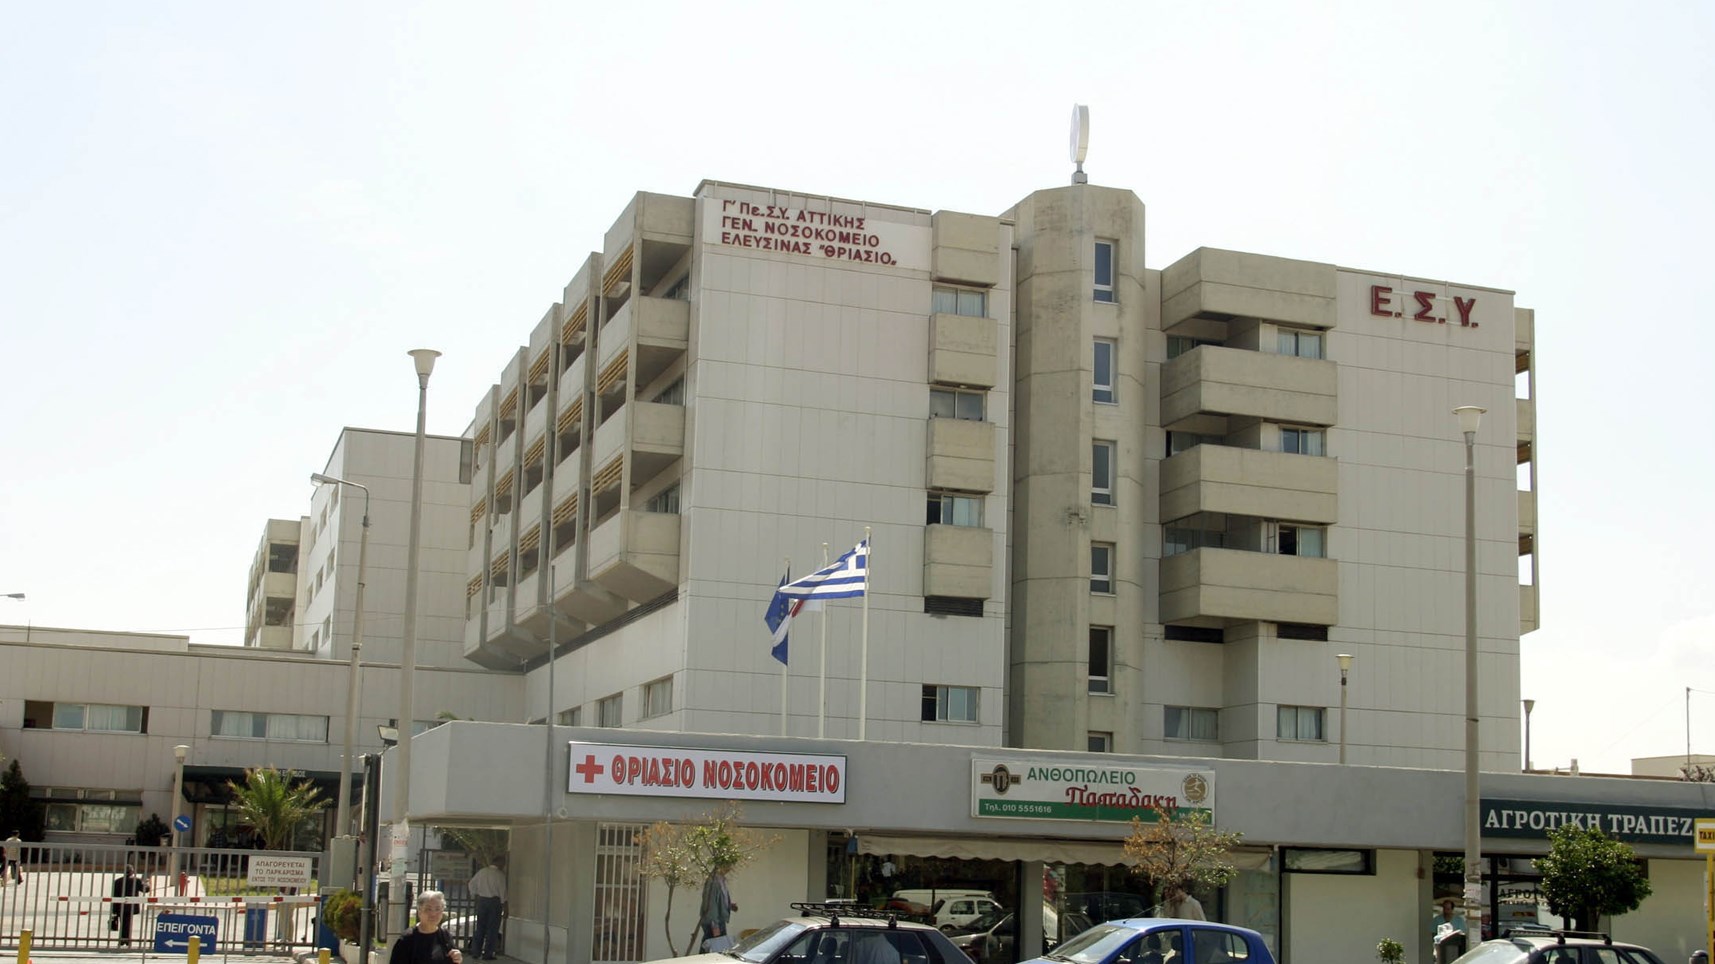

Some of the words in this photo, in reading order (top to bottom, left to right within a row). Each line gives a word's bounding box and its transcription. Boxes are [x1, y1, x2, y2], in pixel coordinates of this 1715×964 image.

[796, 210, 865, 230] ΑΤΤΙΚΗΣ
[721, 232, 811, 255] ΕΛΕΥΣΙΝΑΣ
[764, 221, 880, 248] ΝΟΣΟΚΟΜΕΙΟ
[611, 754, 696, 788] ΘΡΙΑΣΙΟ
[702, 759, 840, 793] ΝΟΣΟΚΟΜΕΙΟ
[1027, 766, 1136, 785] ΑΝΘΟΠΩΛΕΙΟ
[984, 803, 1001, 812] Τηλ.
[1002, 803, 1017, 812] 010
[1485, 809, 1602, 832] ΑΓΡΟΤΙΚΗ
[1608, 813, 1694, 837] ΤΡΑΠΕΖ
[256, 860, 305, 868] ΑΠΑΓΟΡΕΥΕΤΑΙ
[156, 921, 217, 935] ΕΠΕΙΓΟΝΤΑ
